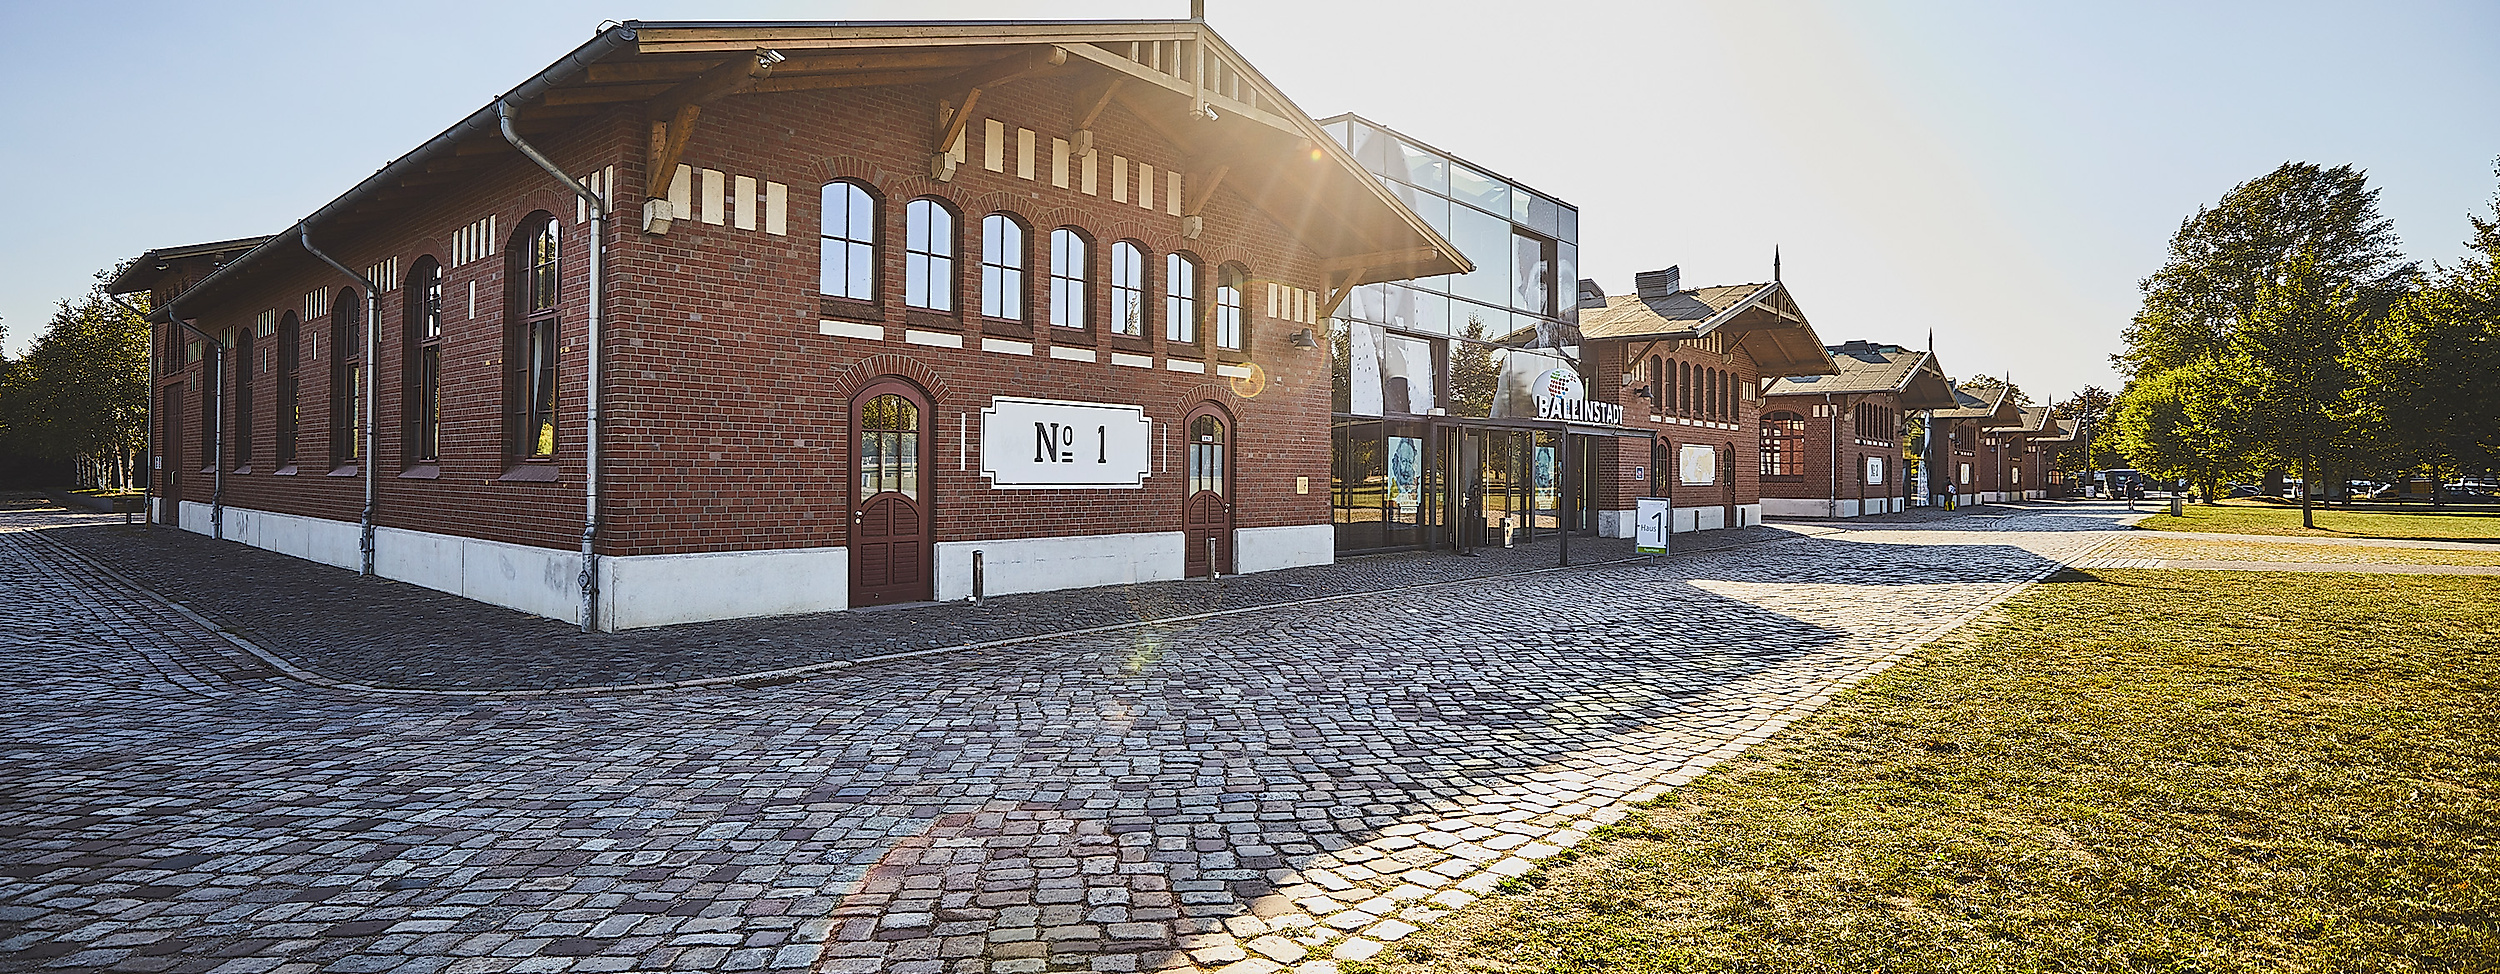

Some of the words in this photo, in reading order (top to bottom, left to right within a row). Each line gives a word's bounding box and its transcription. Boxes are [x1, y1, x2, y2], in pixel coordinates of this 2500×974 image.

[1537, 396, 1624, 425] BALLINSTADT
[1097, 425, 1107, 464] 1
[1640, 524, 1657, 533] Haus
[1651, 511, 1662, 543] 1
